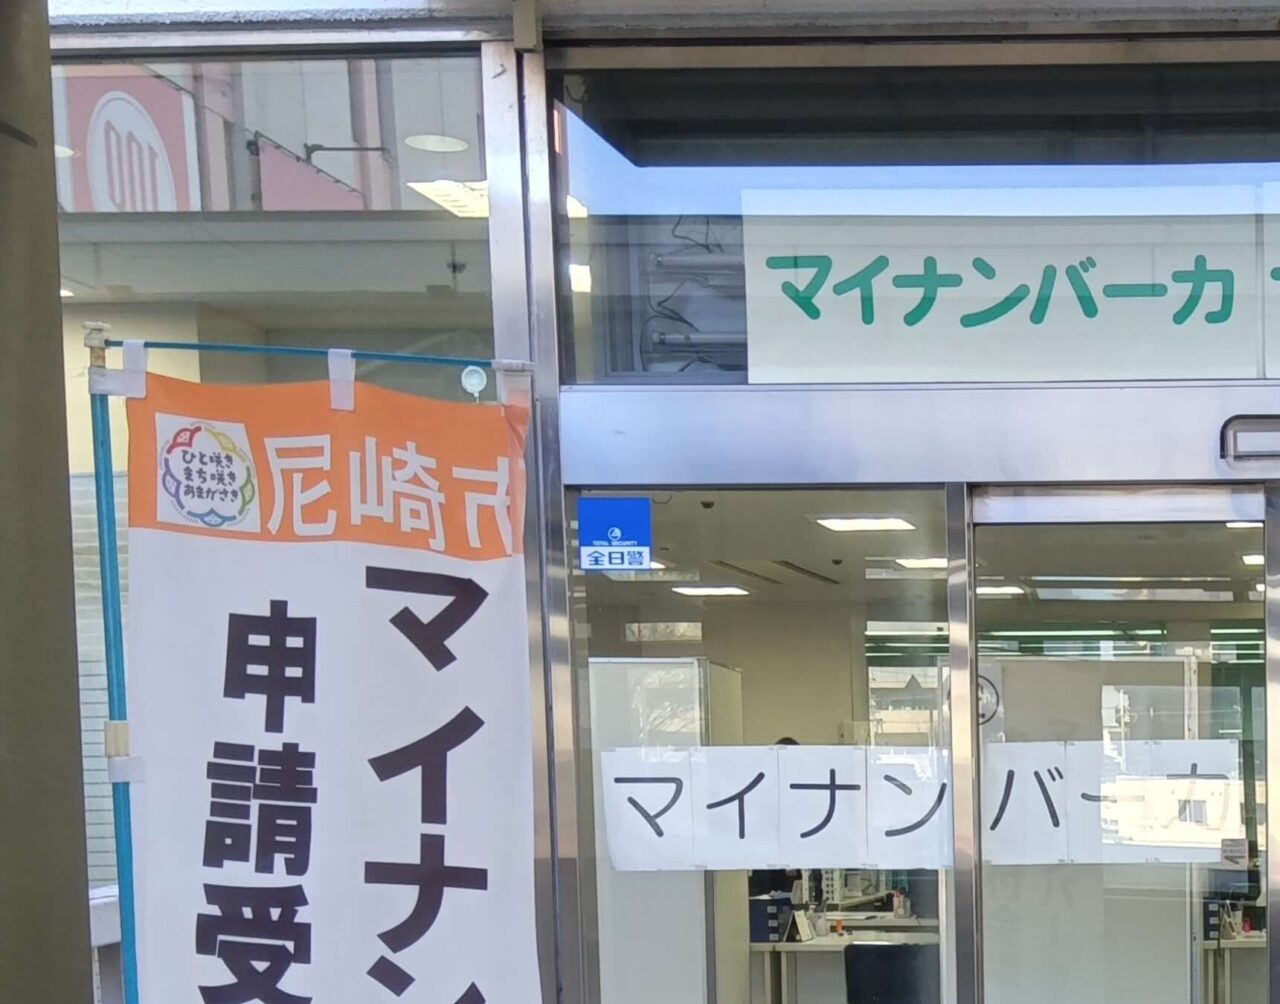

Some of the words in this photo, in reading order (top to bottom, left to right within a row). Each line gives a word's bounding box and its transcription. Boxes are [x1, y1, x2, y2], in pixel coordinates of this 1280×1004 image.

[181, 450, 234, 469] ひと咲き
[183, 466, 236, 486] まち咲き
[183, 484, 239, 503] あまがさき
[586, 550, 644, 566] 全日警
